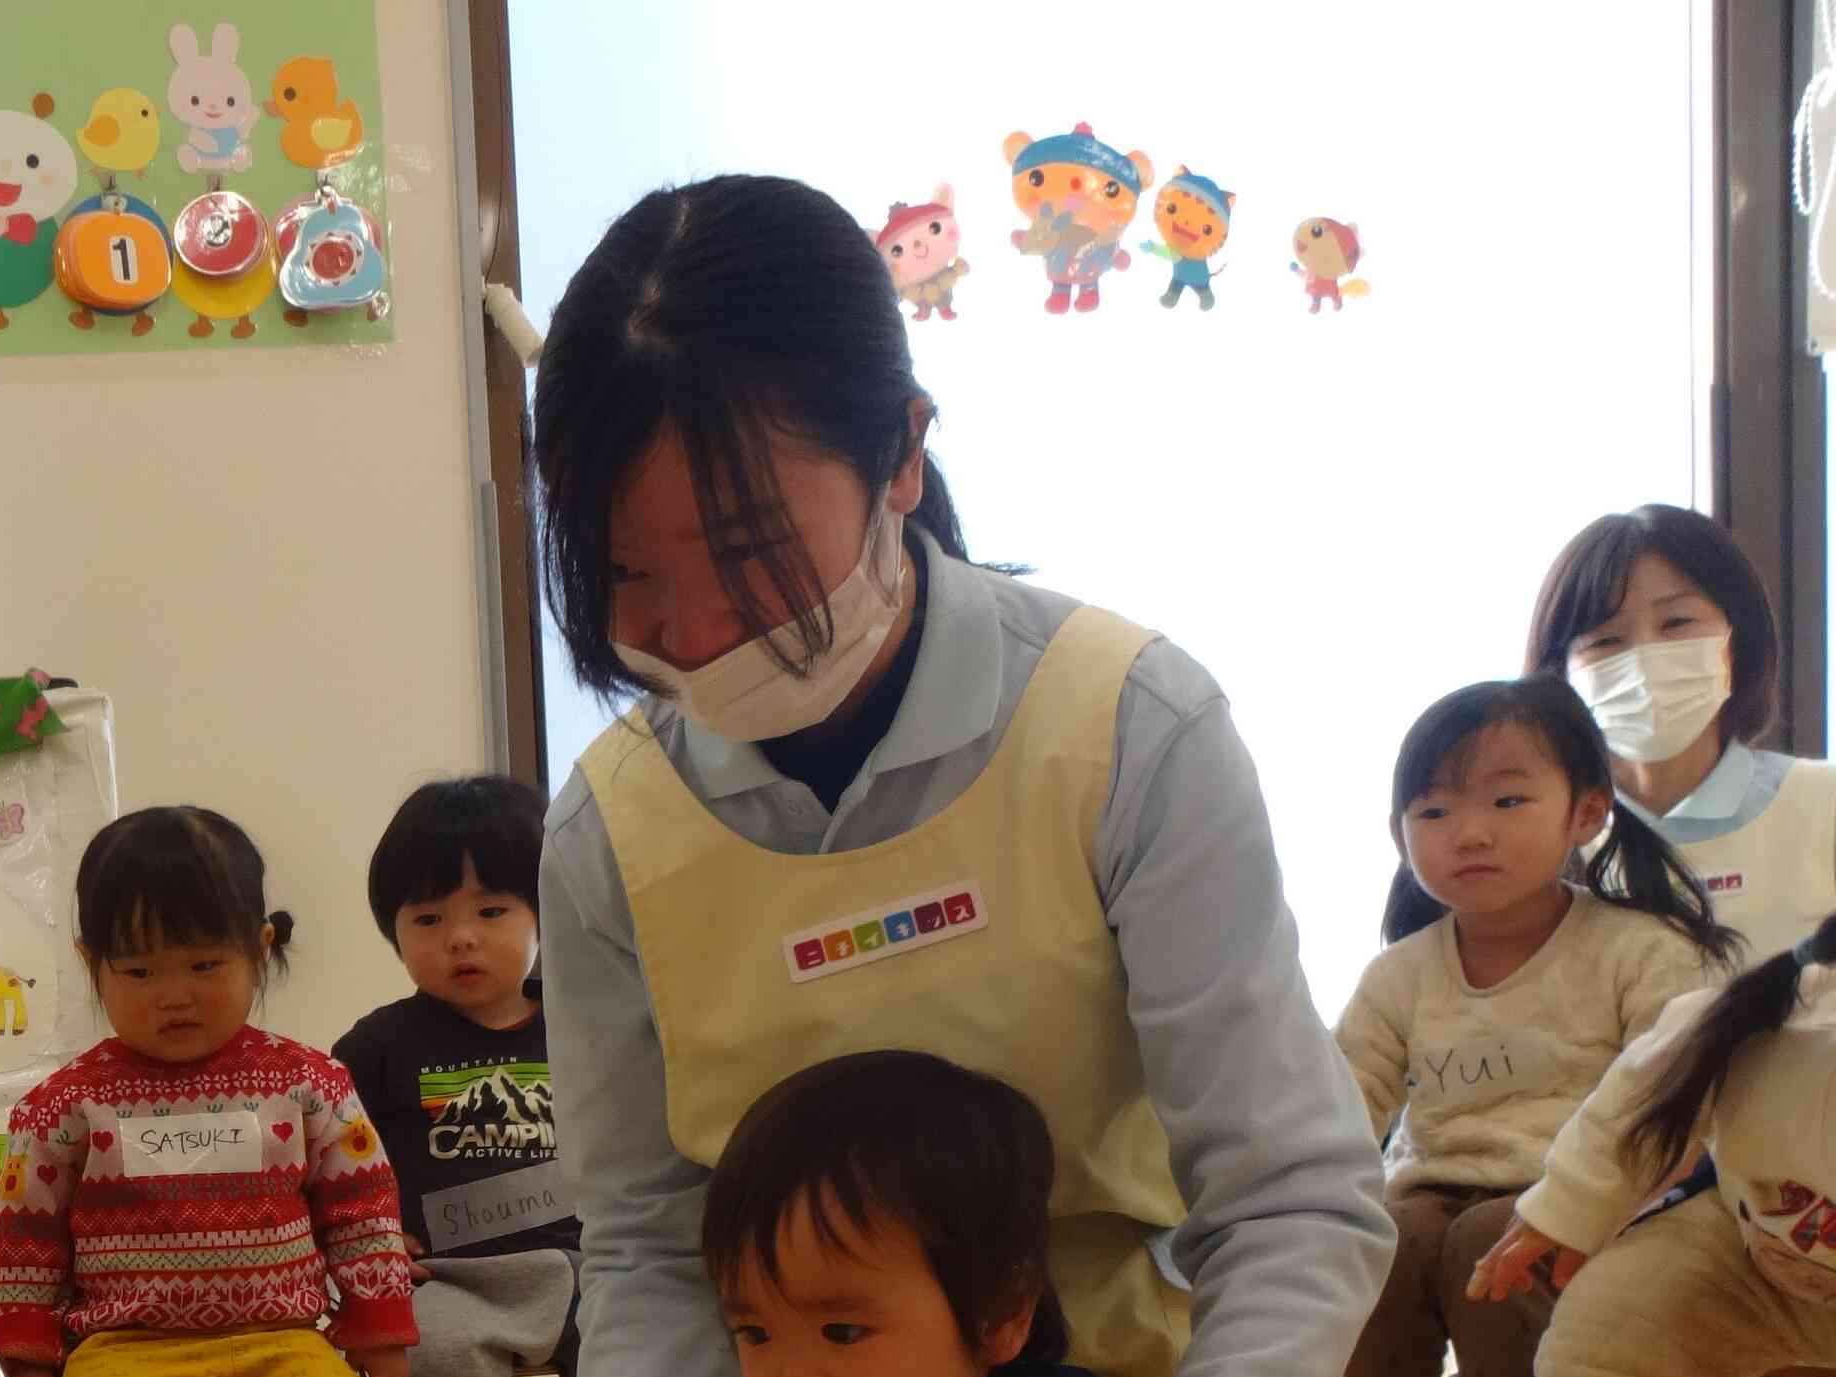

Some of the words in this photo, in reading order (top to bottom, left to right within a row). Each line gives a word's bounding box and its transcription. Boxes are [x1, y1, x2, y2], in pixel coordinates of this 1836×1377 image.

[112, 238, 131, 281] 1
[420, 1056, 518, 1075] MOUNTAIN
[1425, 1045, 1513, 1094] Yui
[140, 1128, 245, 1156] SATSUKI
[465, 1148, 523, 1159] ACTIVE
[443, 1190, 557, 1236] Shouma
